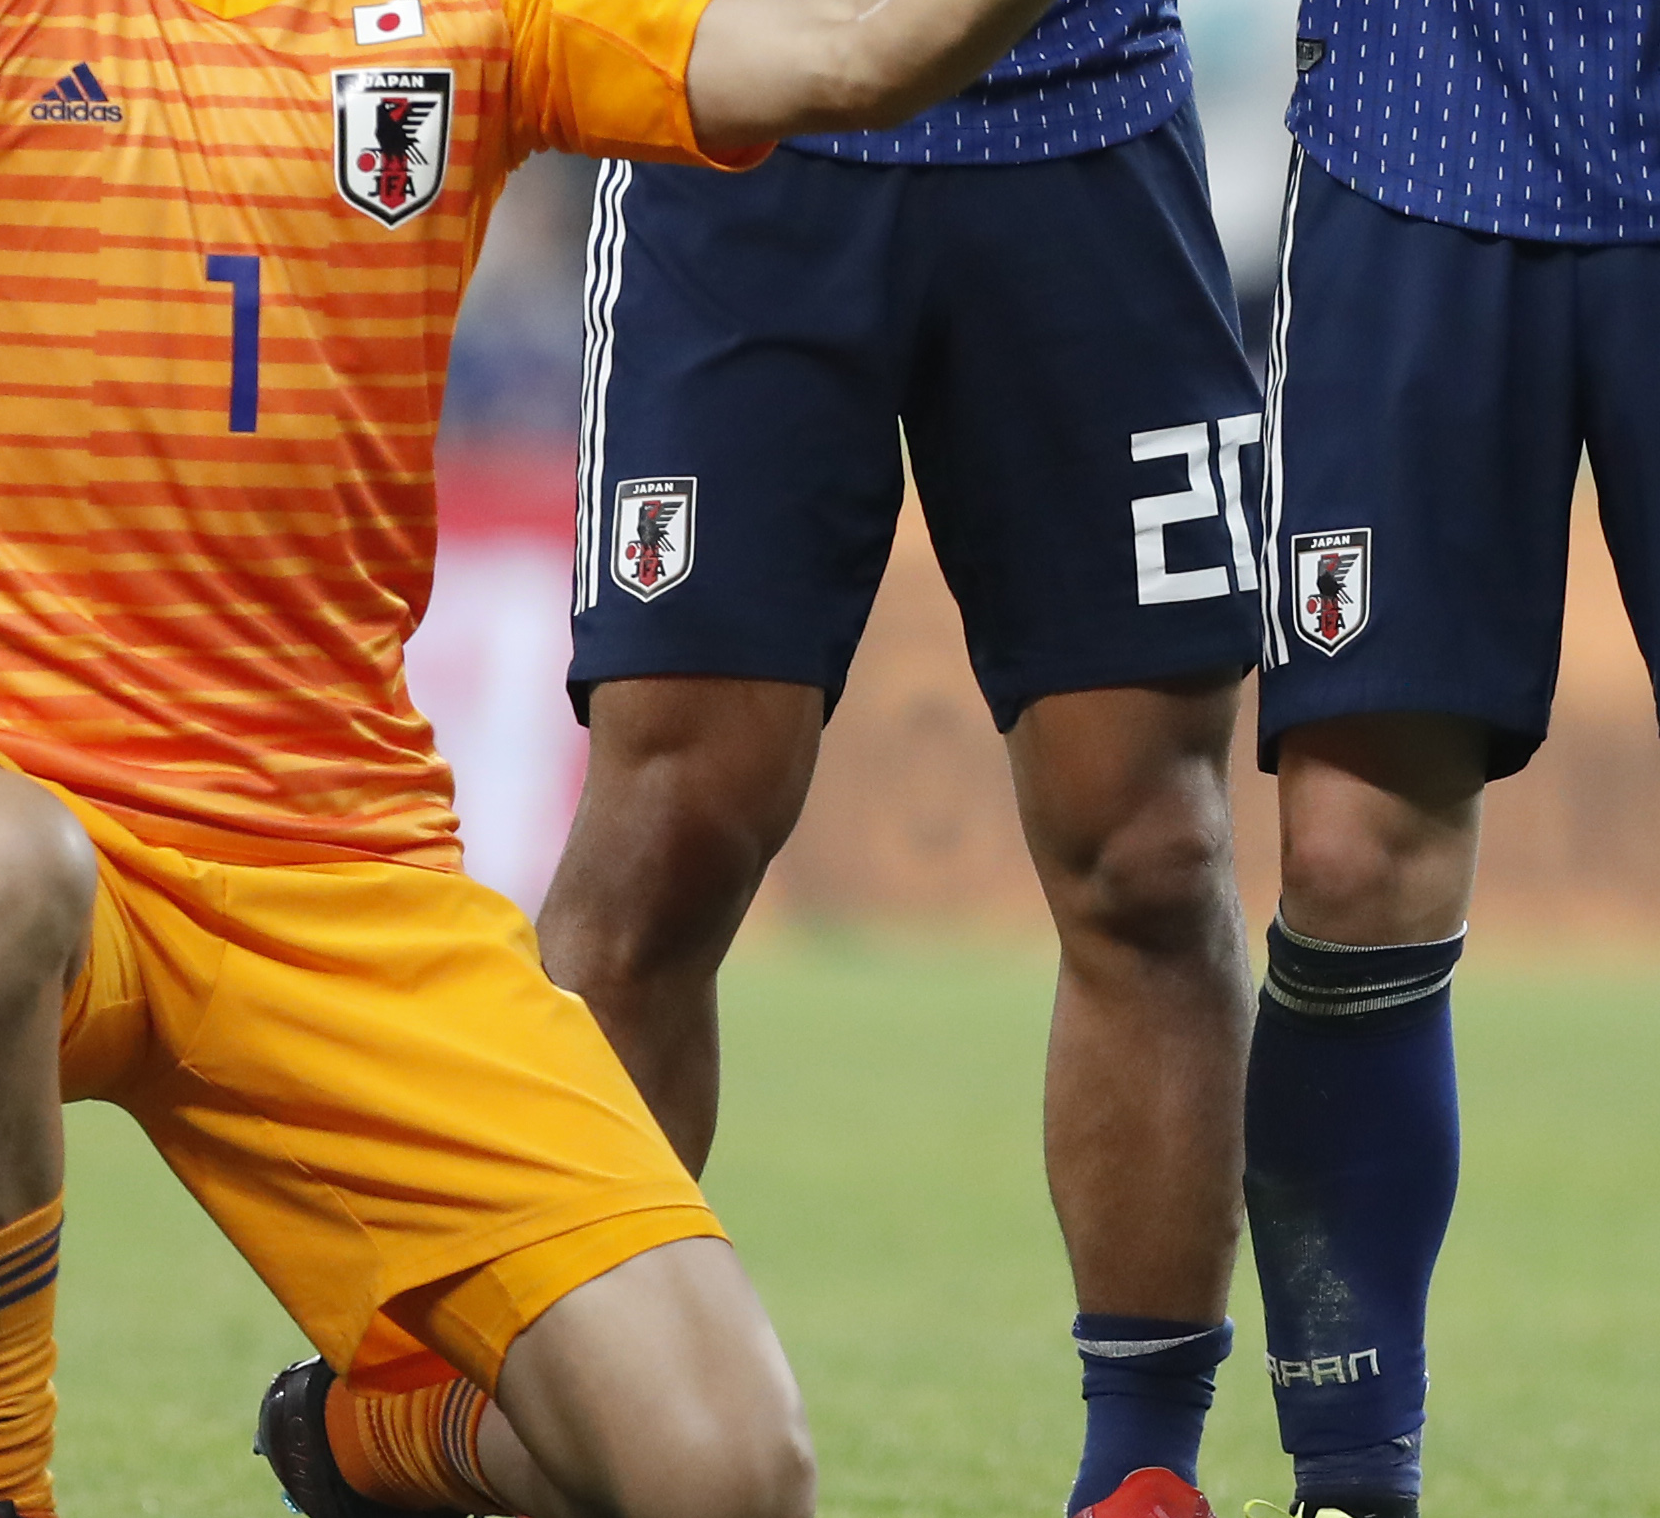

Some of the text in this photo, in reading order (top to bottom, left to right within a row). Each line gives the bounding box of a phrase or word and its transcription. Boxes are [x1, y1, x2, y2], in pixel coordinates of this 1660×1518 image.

[365, 74, 425, 88] JAPAN
[31, 100, 123, 122] adidas
[367, 175, 416, 197] JFA
[206, 254, 260, 433] 1
[633, 483, 674, 494] JAPAN
[1310, 535, 1350, 548] JAPAN
[1265, 1348, 1380, 1388] APAN
